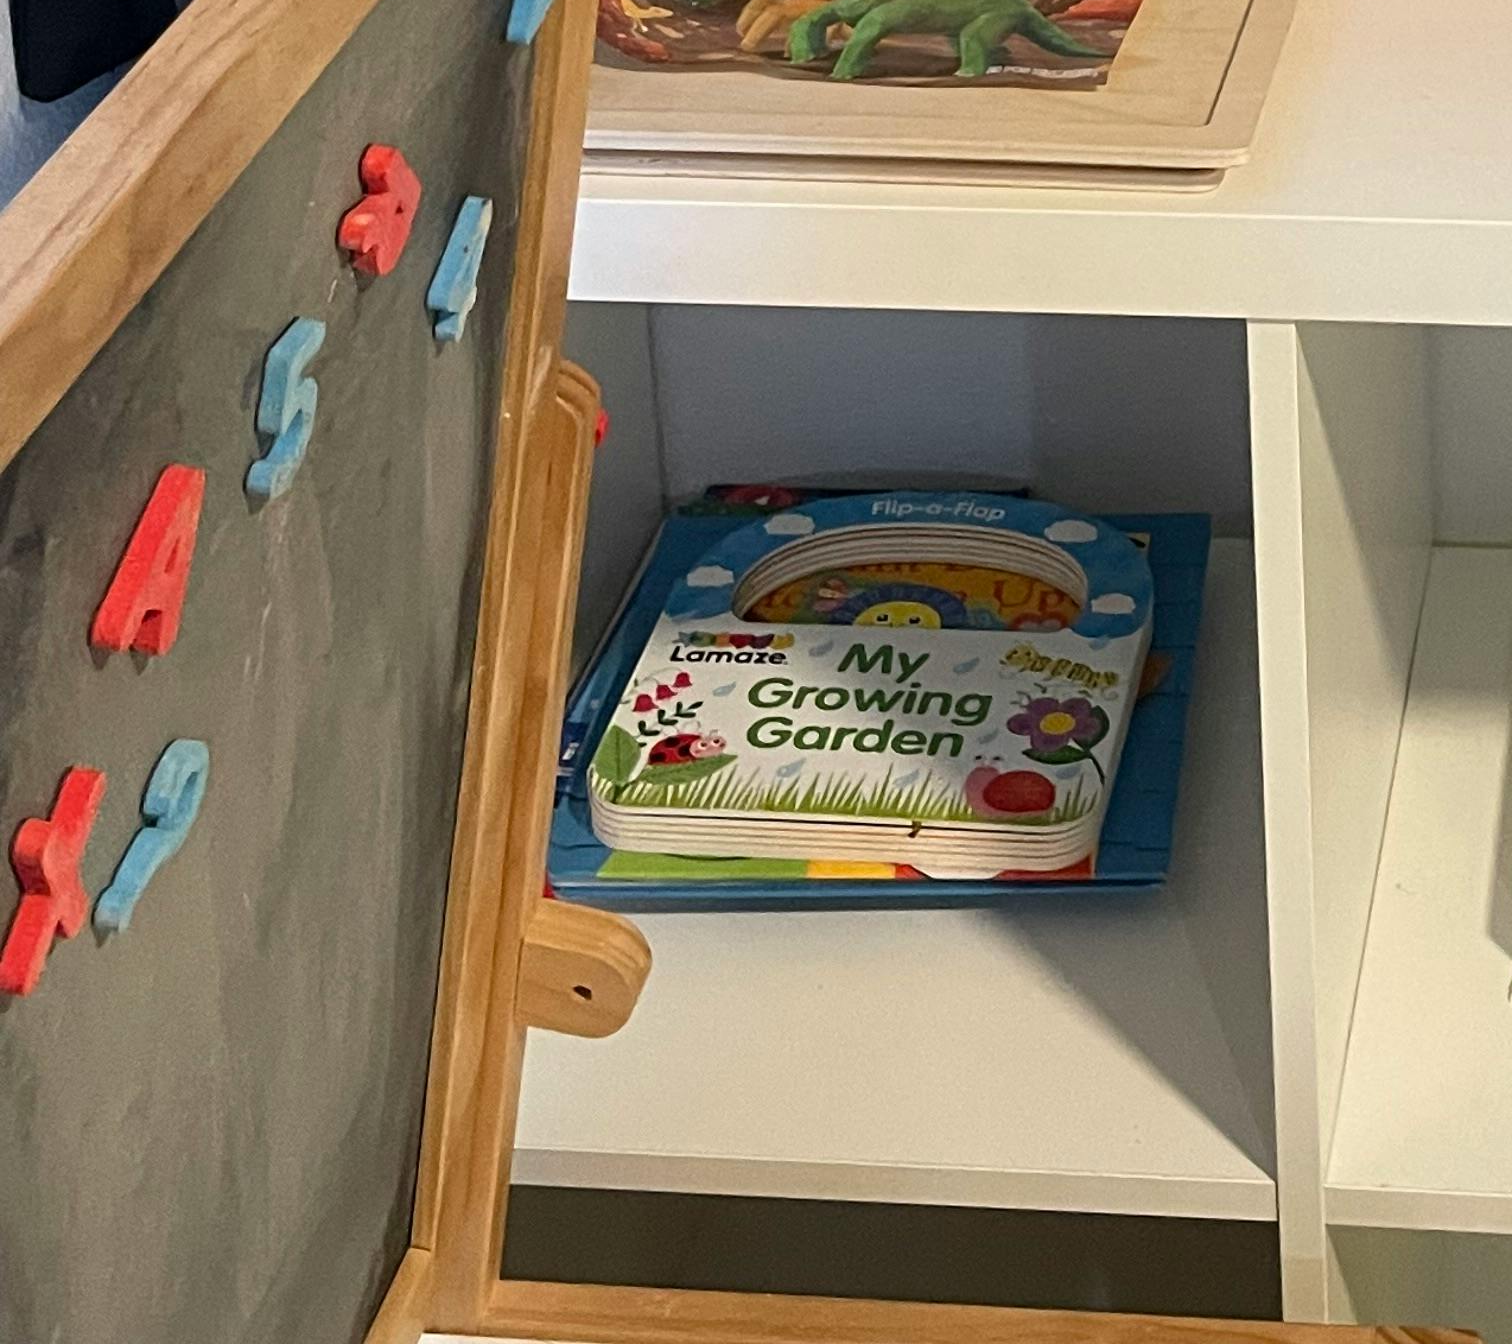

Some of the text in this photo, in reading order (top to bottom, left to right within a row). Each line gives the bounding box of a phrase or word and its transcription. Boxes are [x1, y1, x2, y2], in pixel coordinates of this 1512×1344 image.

[872, 498, 1005, 522] Flip-a-Flap
[92, 463, 205, 656] A
[670, 645, 787, 665] Lamaze
[838, 642, 930, 683] My
[747, 677, 993, 727] Growing
[747, 715, 964, 758] Garden
